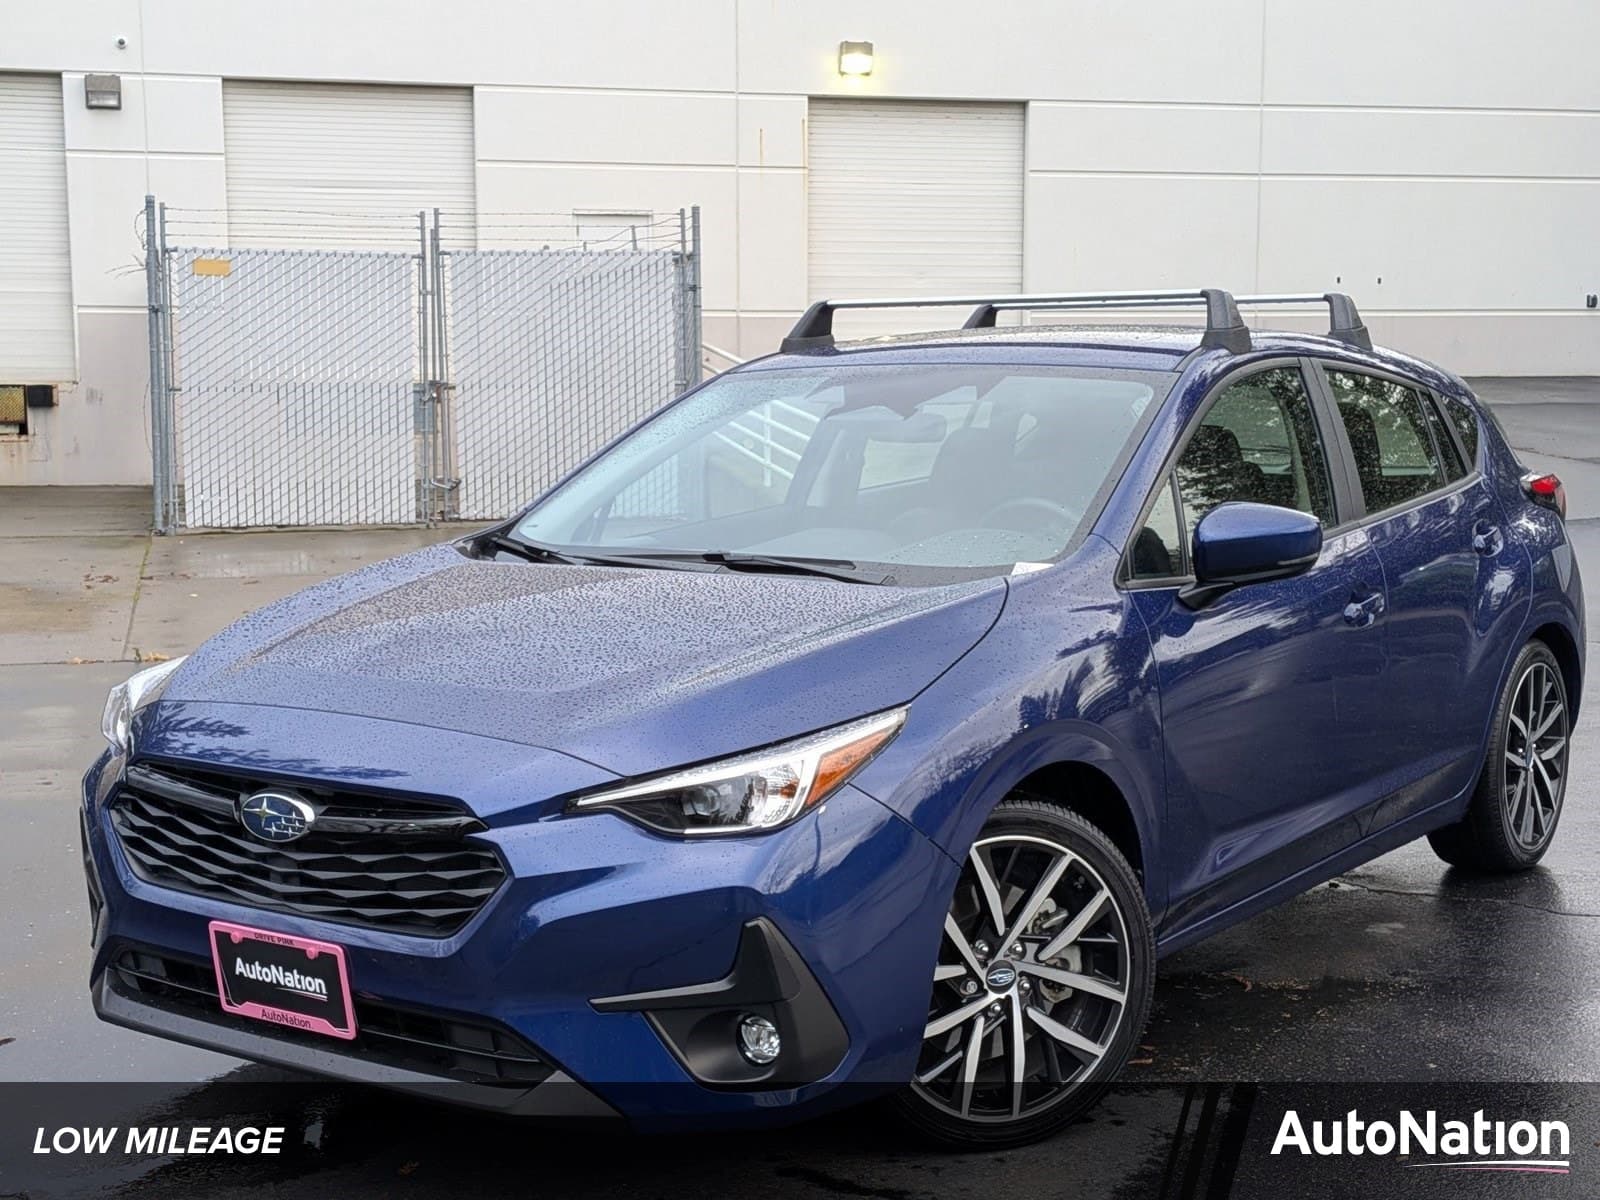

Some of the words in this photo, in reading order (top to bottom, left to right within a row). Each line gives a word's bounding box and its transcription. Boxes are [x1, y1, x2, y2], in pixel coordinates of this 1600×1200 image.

[254, 932, 277, 944] DRIVE
[235, 957, 328, 994] AutoNation
[261, 1009, 312, 1028] AutoNation
